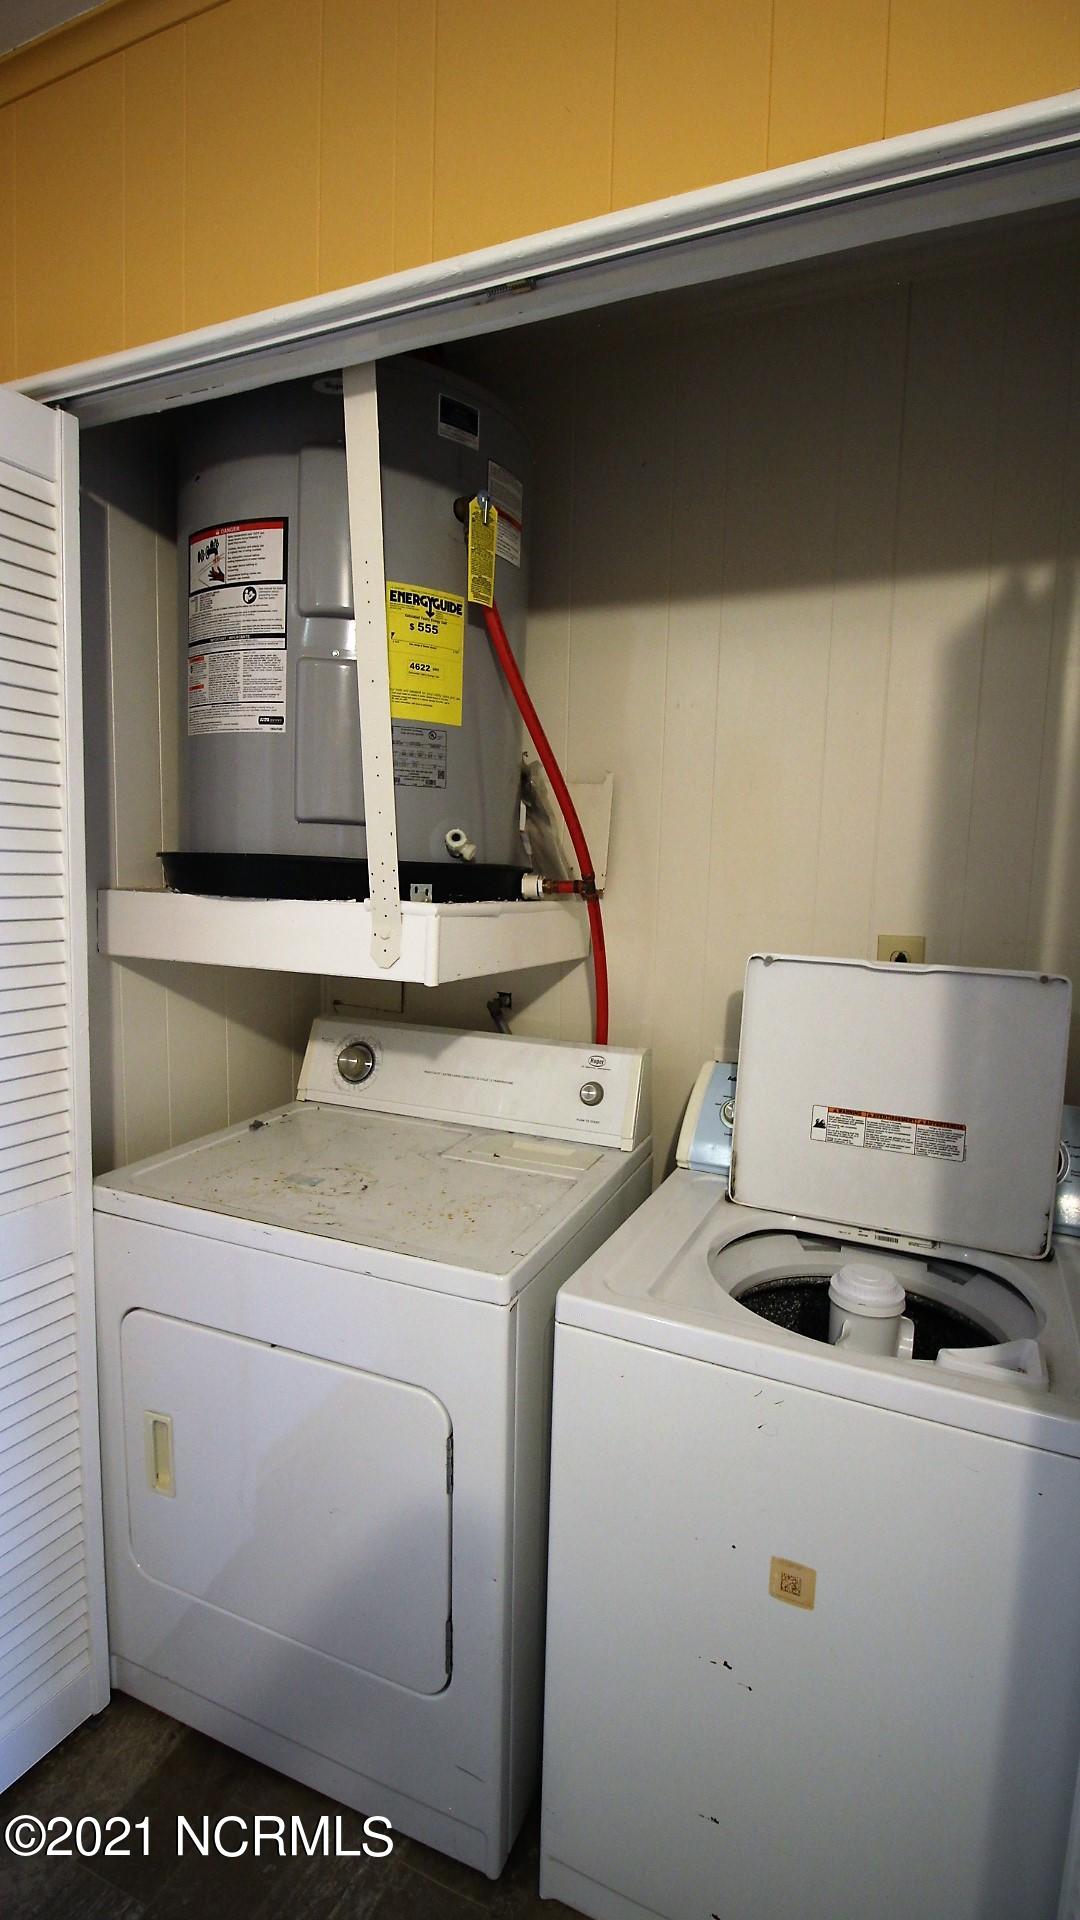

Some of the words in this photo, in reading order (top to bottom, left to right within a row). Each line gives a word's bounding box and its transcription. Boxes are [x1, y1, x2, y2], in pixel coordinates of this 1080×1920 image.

[220, 526, 240, 534] DANGER
[389, 589, 463, 617] ENERGYGUIDE
[417, 621, 439, 635] 555
[409, 662, 431, 672] 4622
